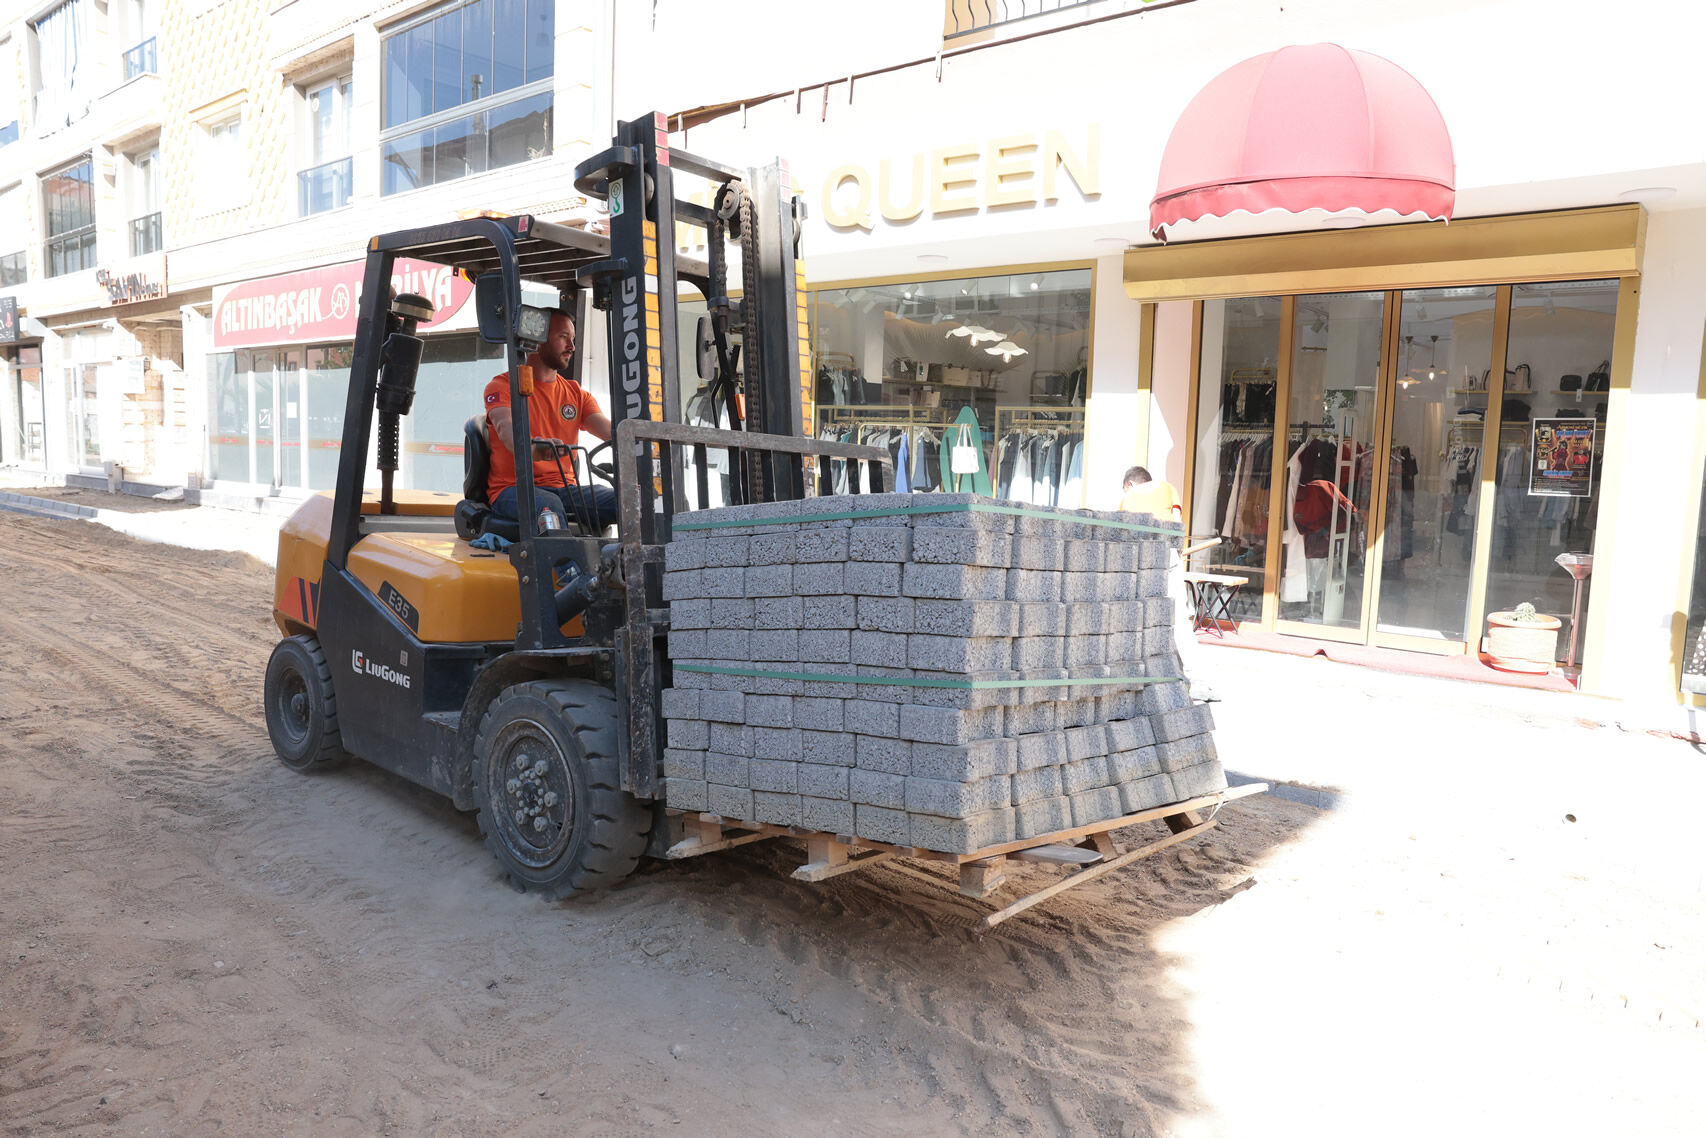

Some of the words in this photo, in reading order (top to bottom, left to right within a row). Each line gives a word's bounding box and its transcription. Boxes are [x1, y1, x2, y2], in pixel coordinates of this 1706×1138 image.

[820, 121, 1101, 231] QUEEN
[221, 287, 322, 336] ALTINBAŞAK
[389, 589, 410, 619] E35
